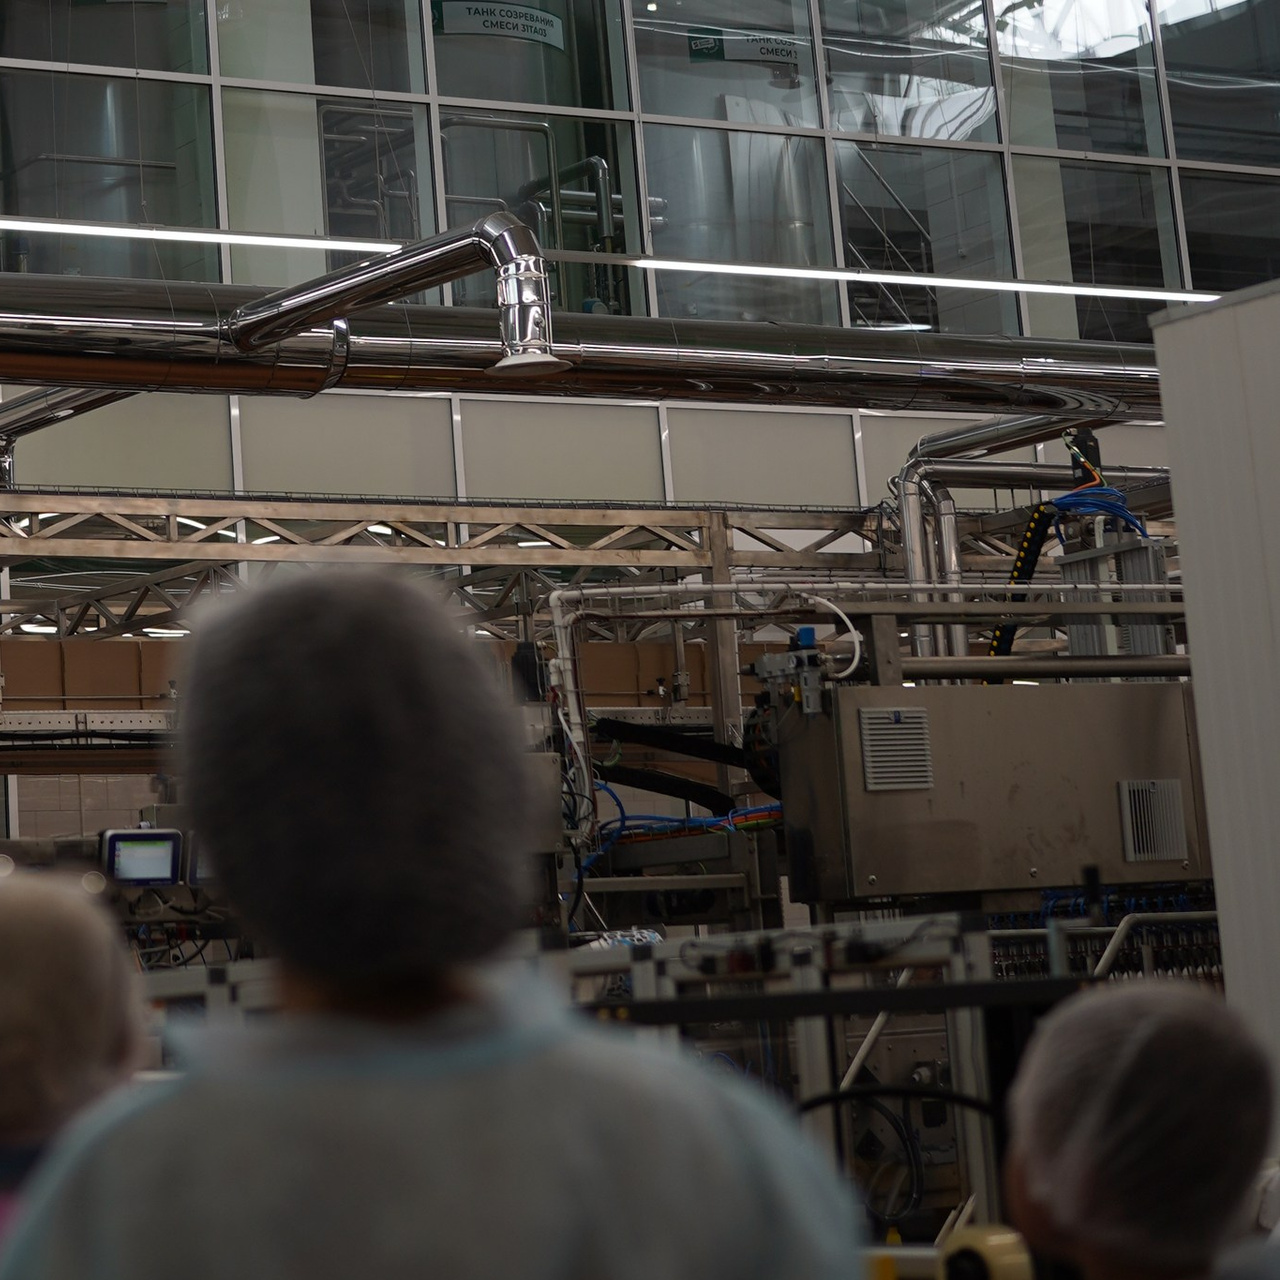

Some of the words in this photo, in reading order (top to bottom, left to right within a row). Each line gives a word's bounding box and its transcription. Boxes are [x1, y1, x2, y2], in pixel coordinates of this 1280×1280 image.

[466, 7, 496, 17] ТАНК
[499, 9, 555, 28] СОЗРЕВАНИЯ
[482, 20, 519, 32] СМЕСИ
[759, 47, 793, 59] СМЕСИ
